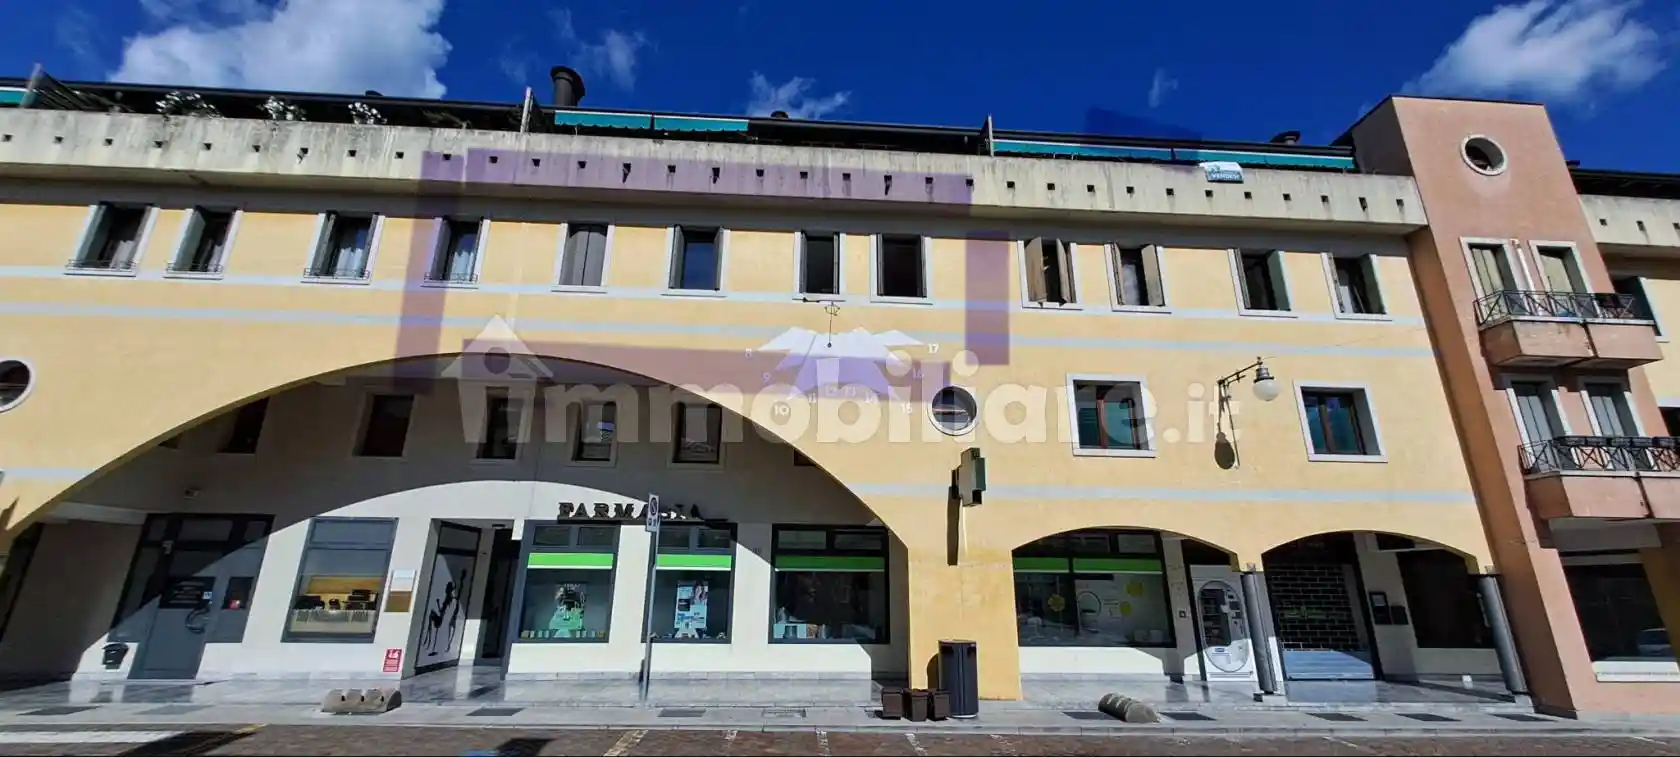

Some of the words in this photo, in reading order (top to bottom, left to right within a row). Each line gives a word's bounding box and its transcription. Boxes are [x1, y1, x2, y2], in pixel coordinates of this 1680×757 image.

[745, 348, 752, 359] 8
[928, 343, 940, 354] 17
[763, 371, 772, 384] 9
[774, 404, 790, 416] 10
